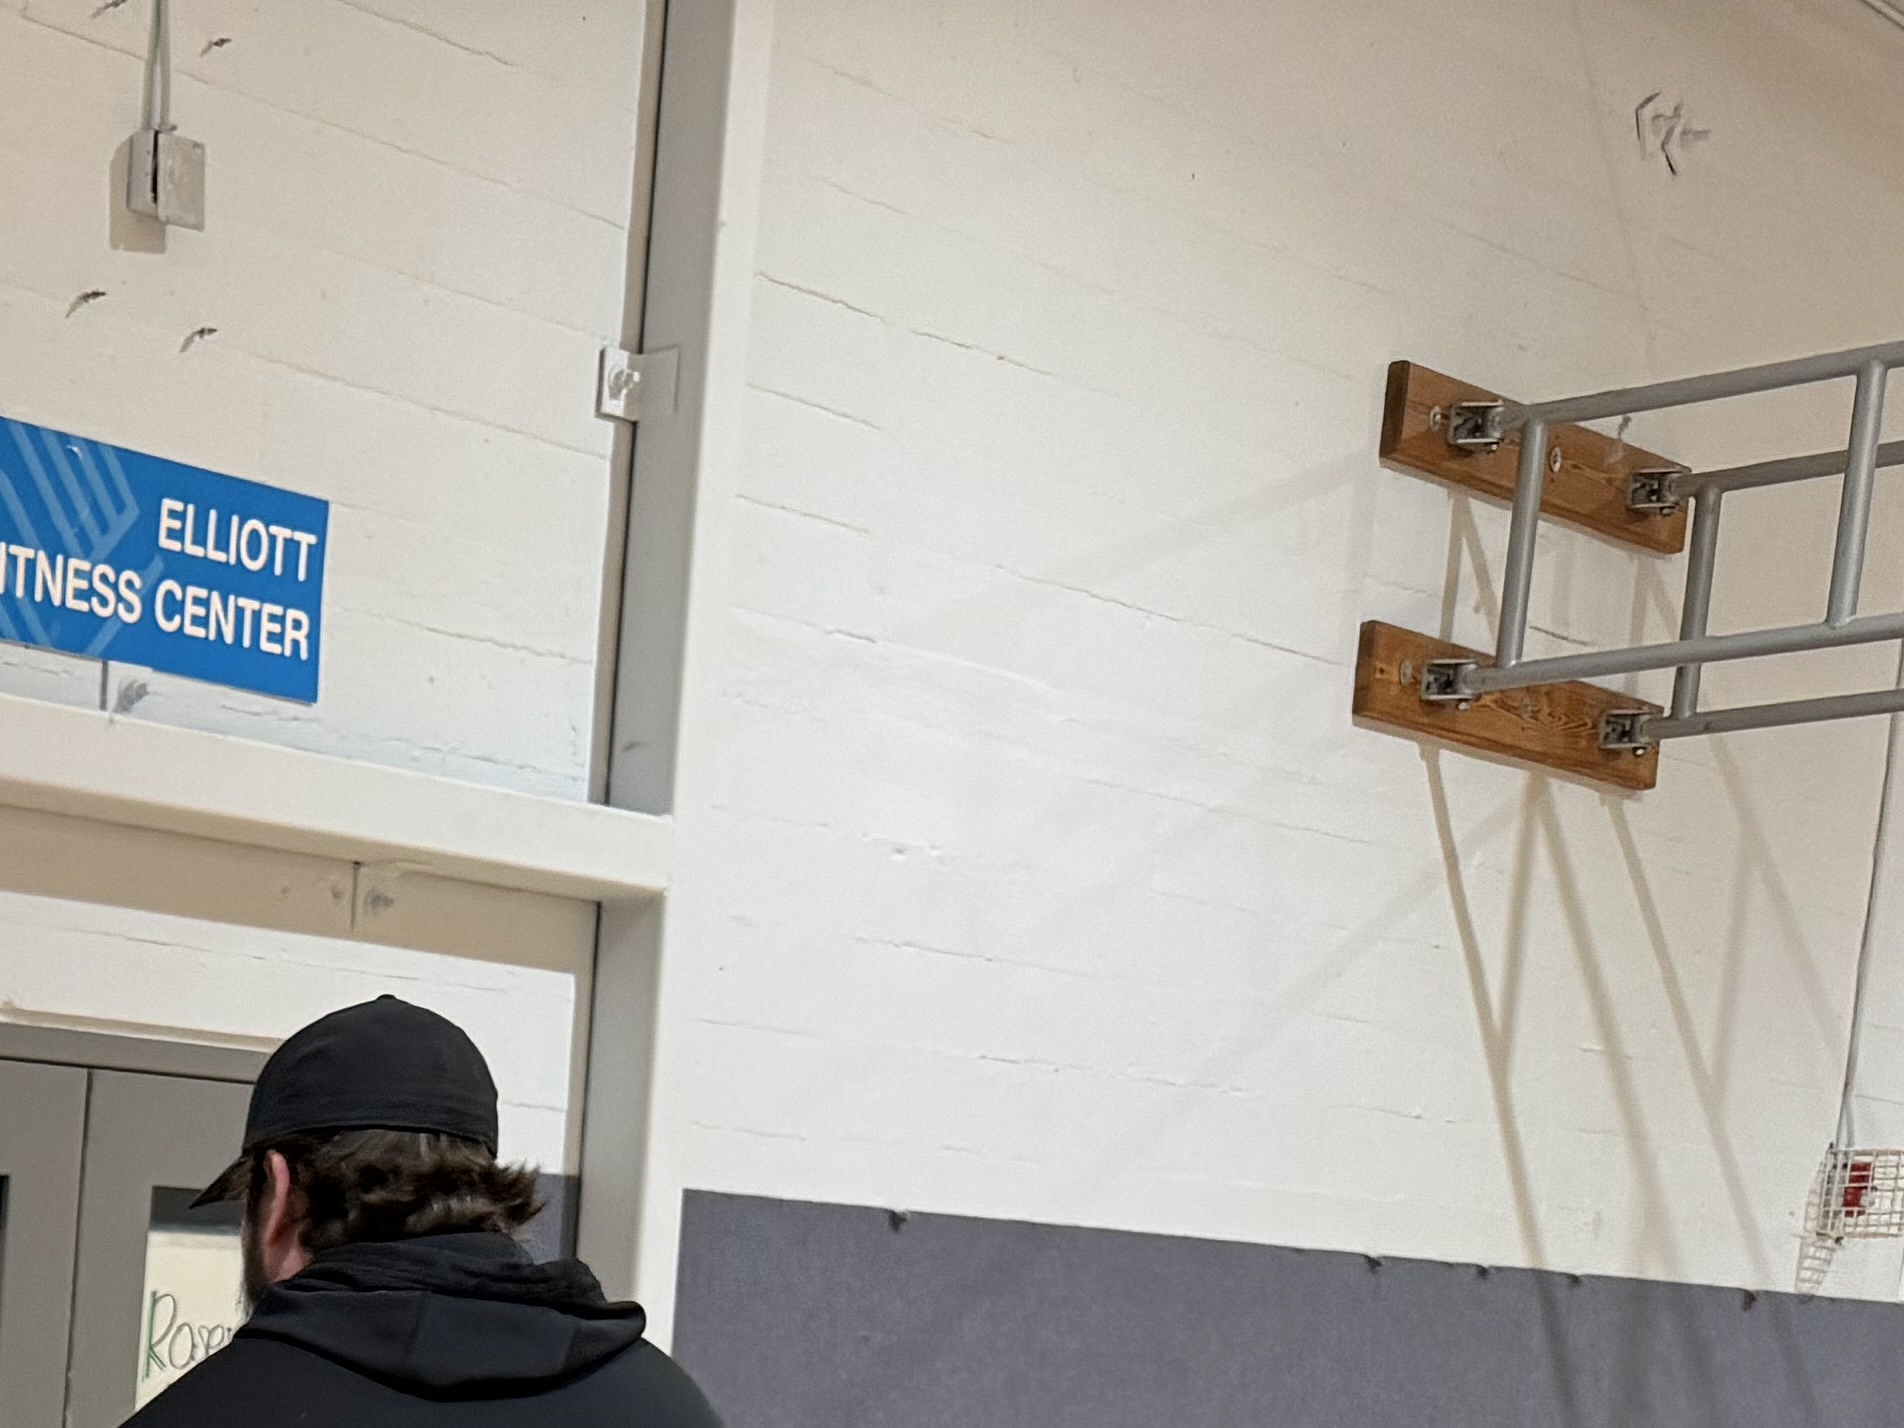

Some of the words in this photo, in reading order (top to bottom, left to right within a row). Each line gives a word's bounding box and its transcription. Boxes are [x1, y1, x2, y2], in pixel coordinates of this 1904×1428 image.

[158, 498, 317, 582] ELLIOTT
[155, 579, 309, 661] CENTER
[142, 1290, 232, 1382] Rose
